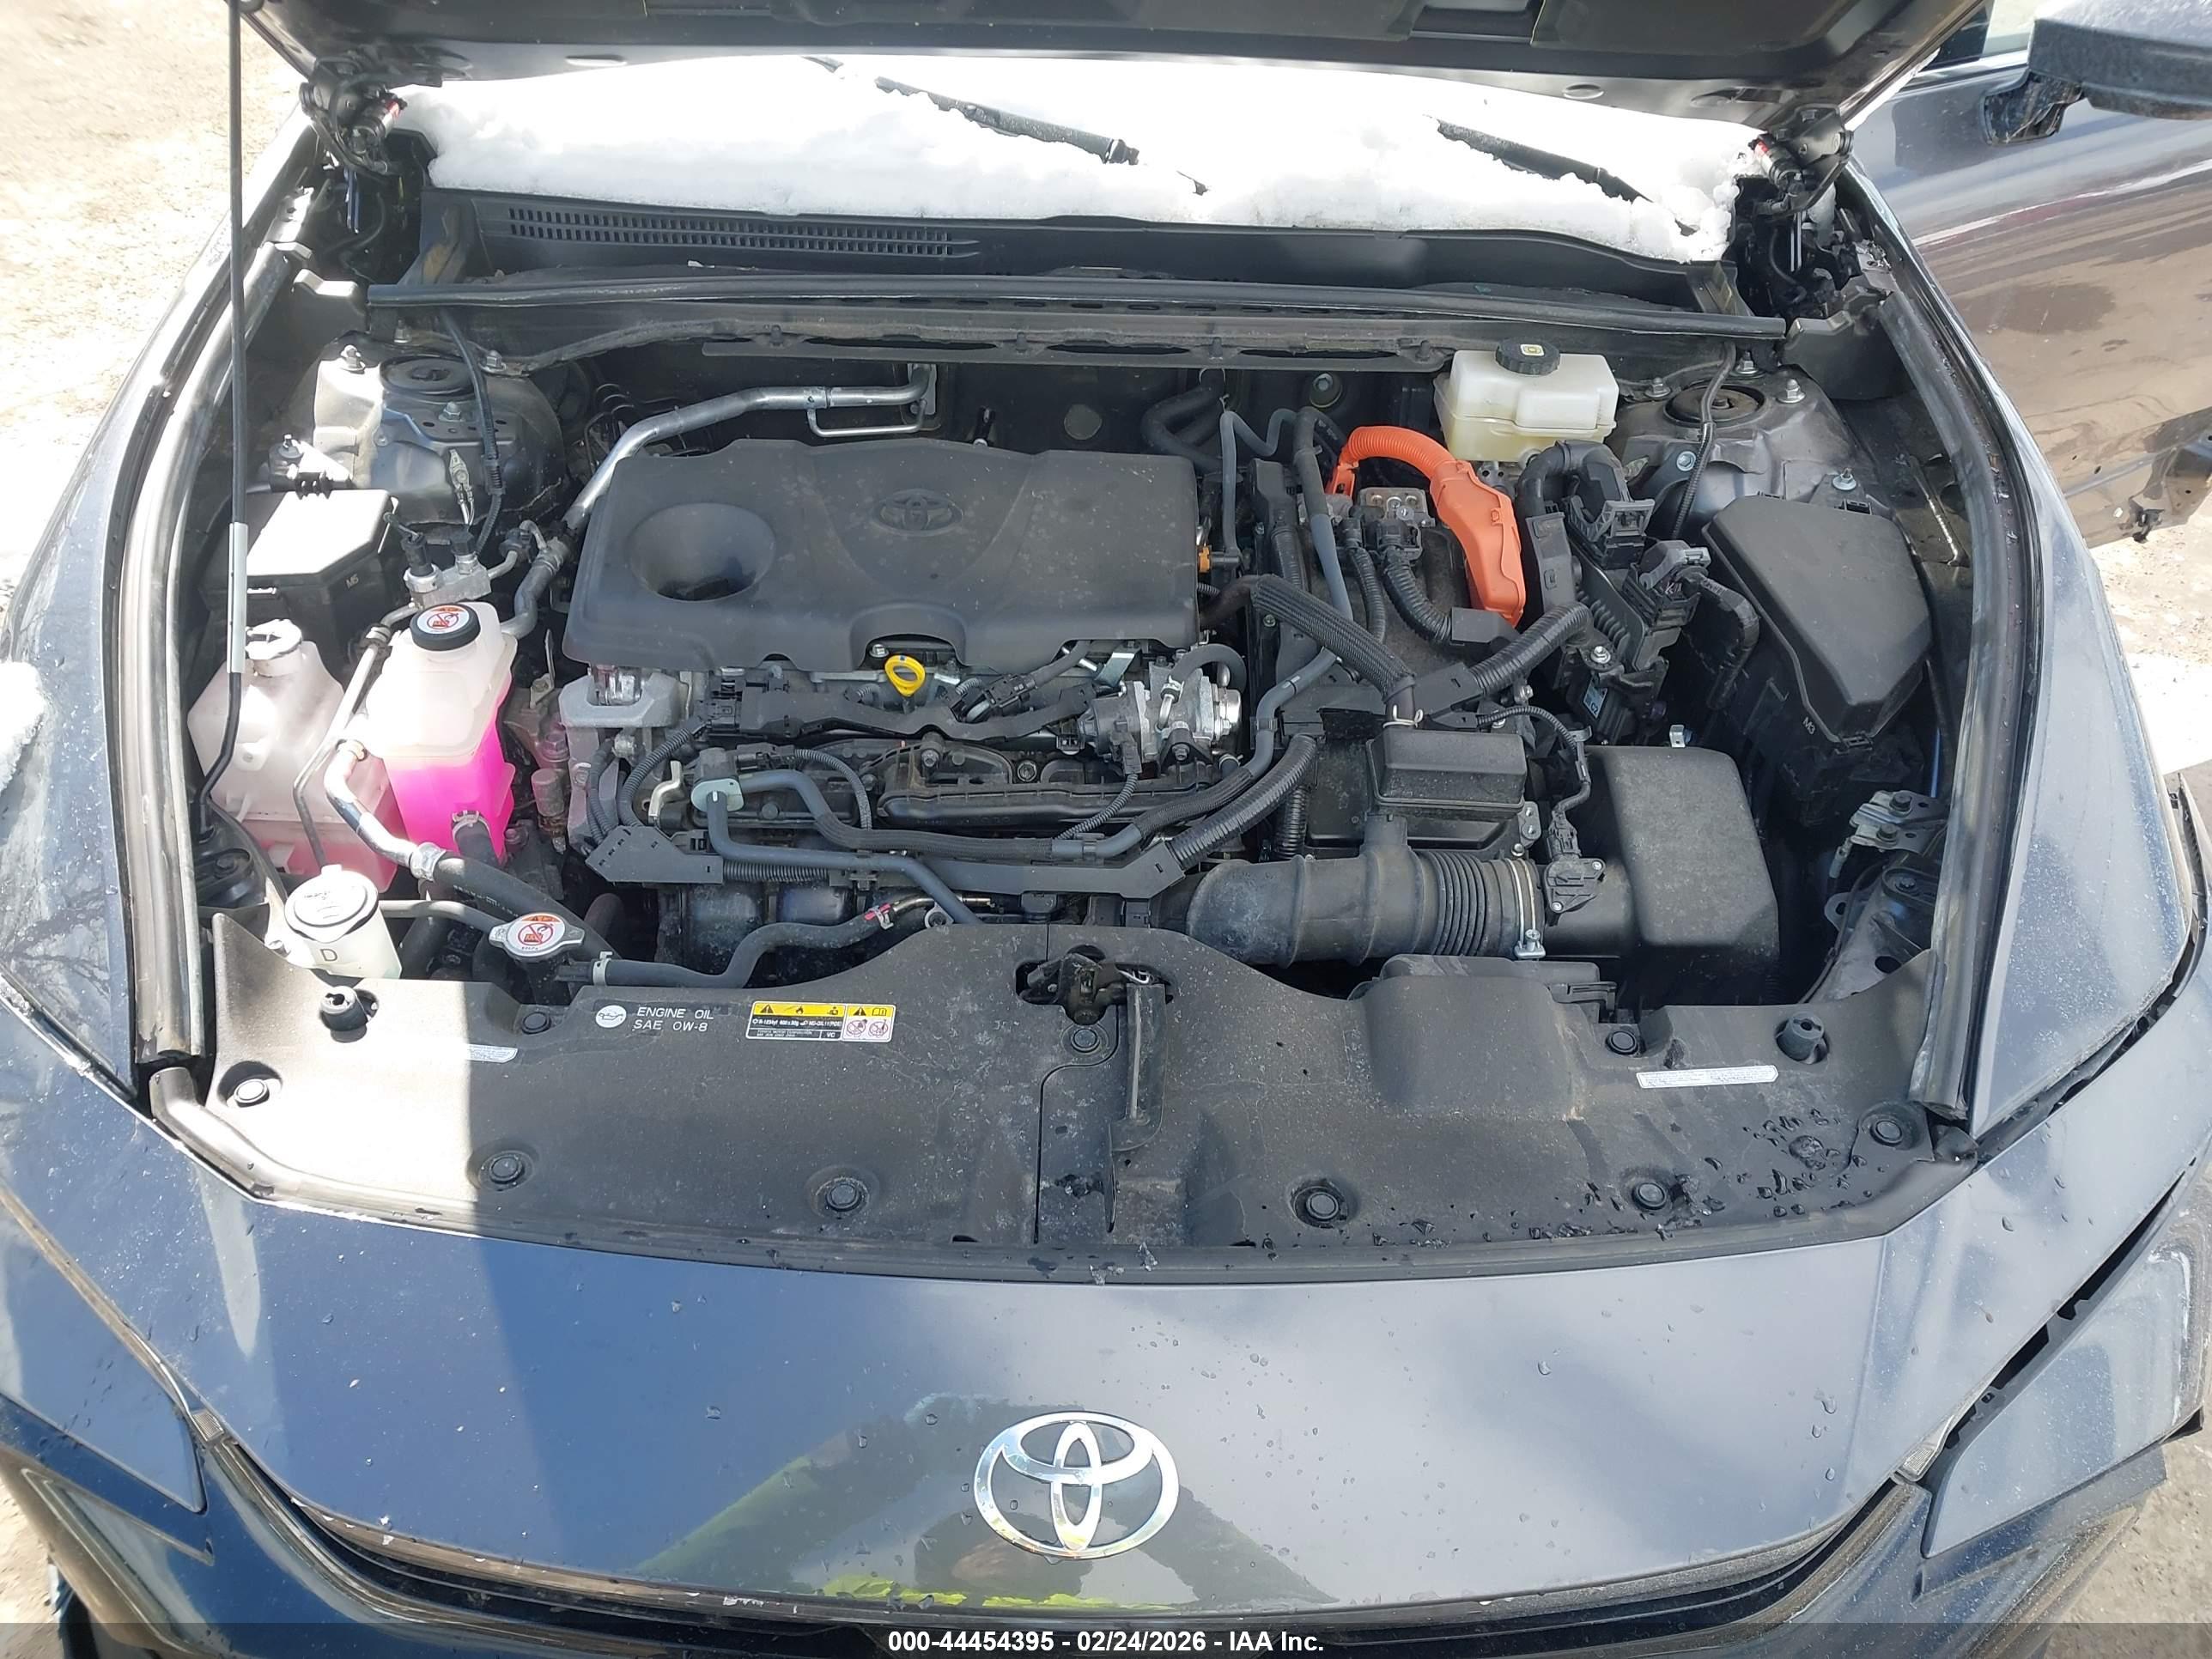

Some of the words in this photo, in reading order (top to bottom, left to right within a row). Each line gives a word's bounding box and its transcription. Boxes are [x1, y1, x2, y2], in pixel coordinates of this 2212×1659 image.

[1802, 716, 1816, 735] M3
[319, 948, 338, 962] D
[636, 1006, 686, 1019] ENGINE
[694, 1009, 714, 1020] OIL
[633, 1019, 664, 1030] SAE
[672, 1020, 708, 1032] 0W-8
